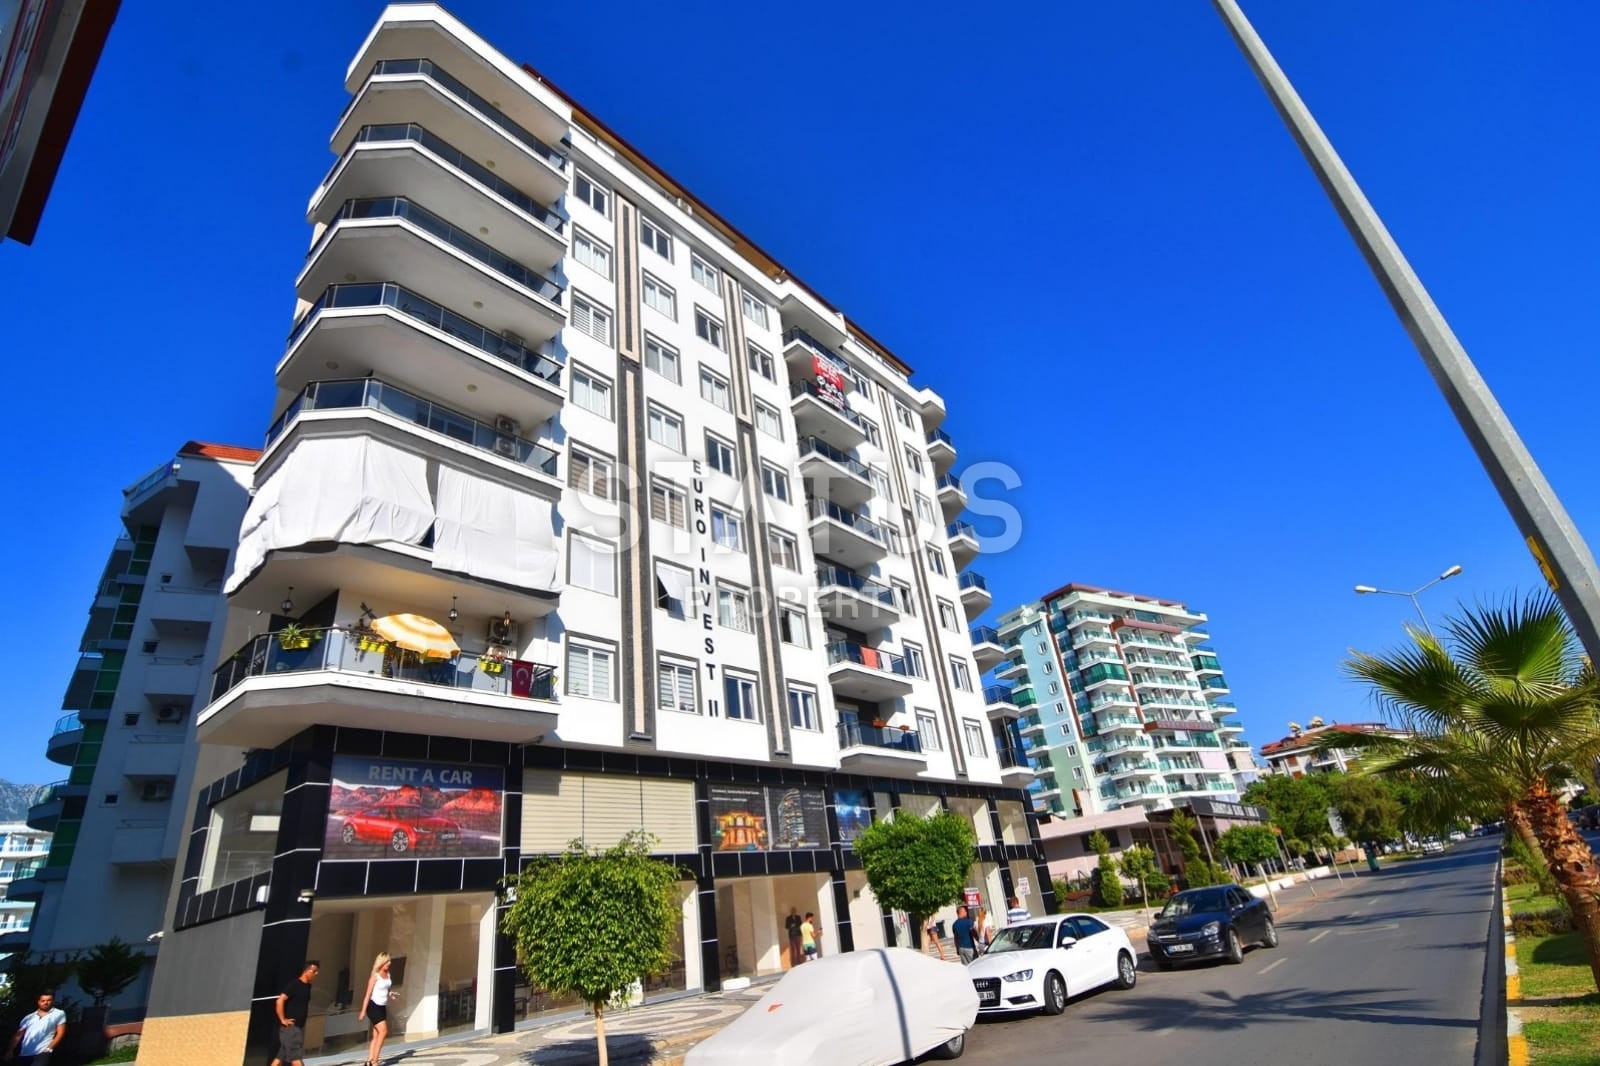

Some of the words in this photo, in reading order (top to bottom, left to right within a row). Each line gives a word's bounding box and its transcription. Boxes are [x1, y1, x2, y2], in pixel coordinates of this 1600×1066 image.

[693, 460, 707, 535] EURO
[699, 547, 716, 680] INVEST
[368, 765, 419, 782] RENT
[422, 769, 434, 783] A
[439, 769, 473, 785] CAR
